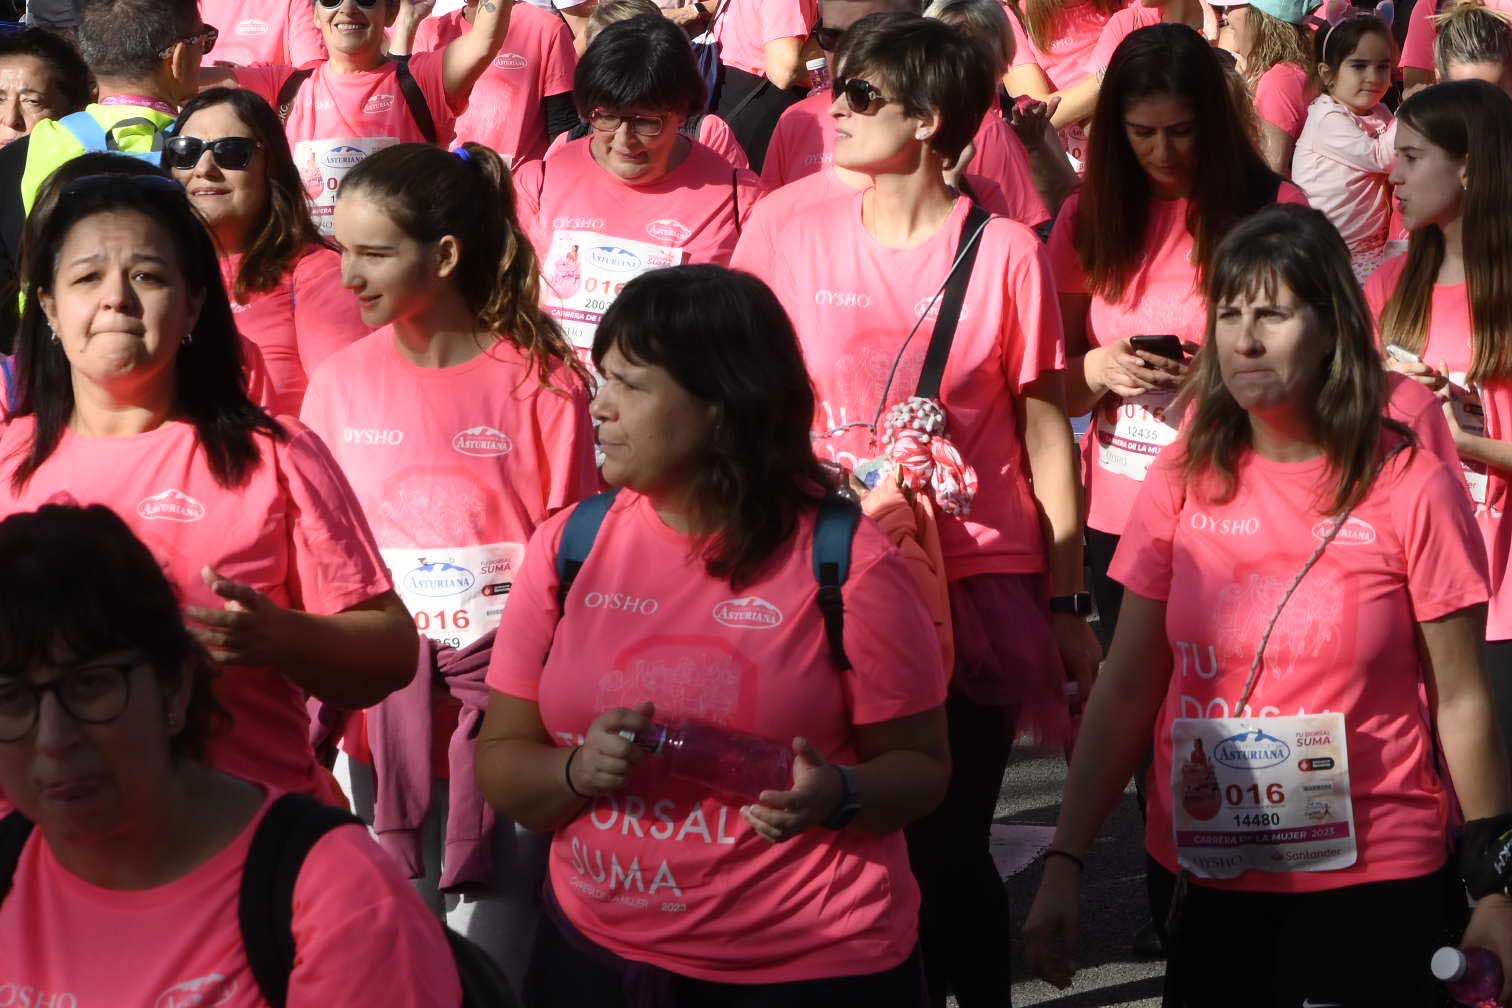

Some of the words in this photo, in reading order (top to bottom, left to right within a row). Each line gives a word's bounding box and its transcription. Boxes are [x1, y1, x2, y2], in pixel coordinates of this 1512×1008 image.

[553, 217, 604, 229] OYSHO
[815, 290, 871, 308] OYSHO
[1128, 425, 1158, 440] 12435
[457, 437, 508, 451] ASTURIANA
[1128, 442, 1137, 451] DE
[1137, 444, 1147, 452] LA
[1190, 512, 1260, 537] OYSHO
[481, 563, 512, 575] SUMA
[409, 575, 471, 589] ASTURIANA
[584, 591, 659, 616] OYSHO
[717, 603, 778, 626] ASTURIANA
[1176, 639, 1219, 680] TU
[1296, 736, 1332, 747] SUMA
[1219, 747, 1285, 761] ASTURIANA
[1225, 783, 1286, 807] 016
[1232, 812, 1281, 828] 14480
[1193, 834, 1238, 844] CARRERA
[1271, 831, 1307, 842] MUJER
[1311, 828, 1335, 839] 2023
[1193, 854, 1243, 868] OYSHO
[1285, 847, 1343, 862] Santander
[571, 836, 683, 897] SUMA
